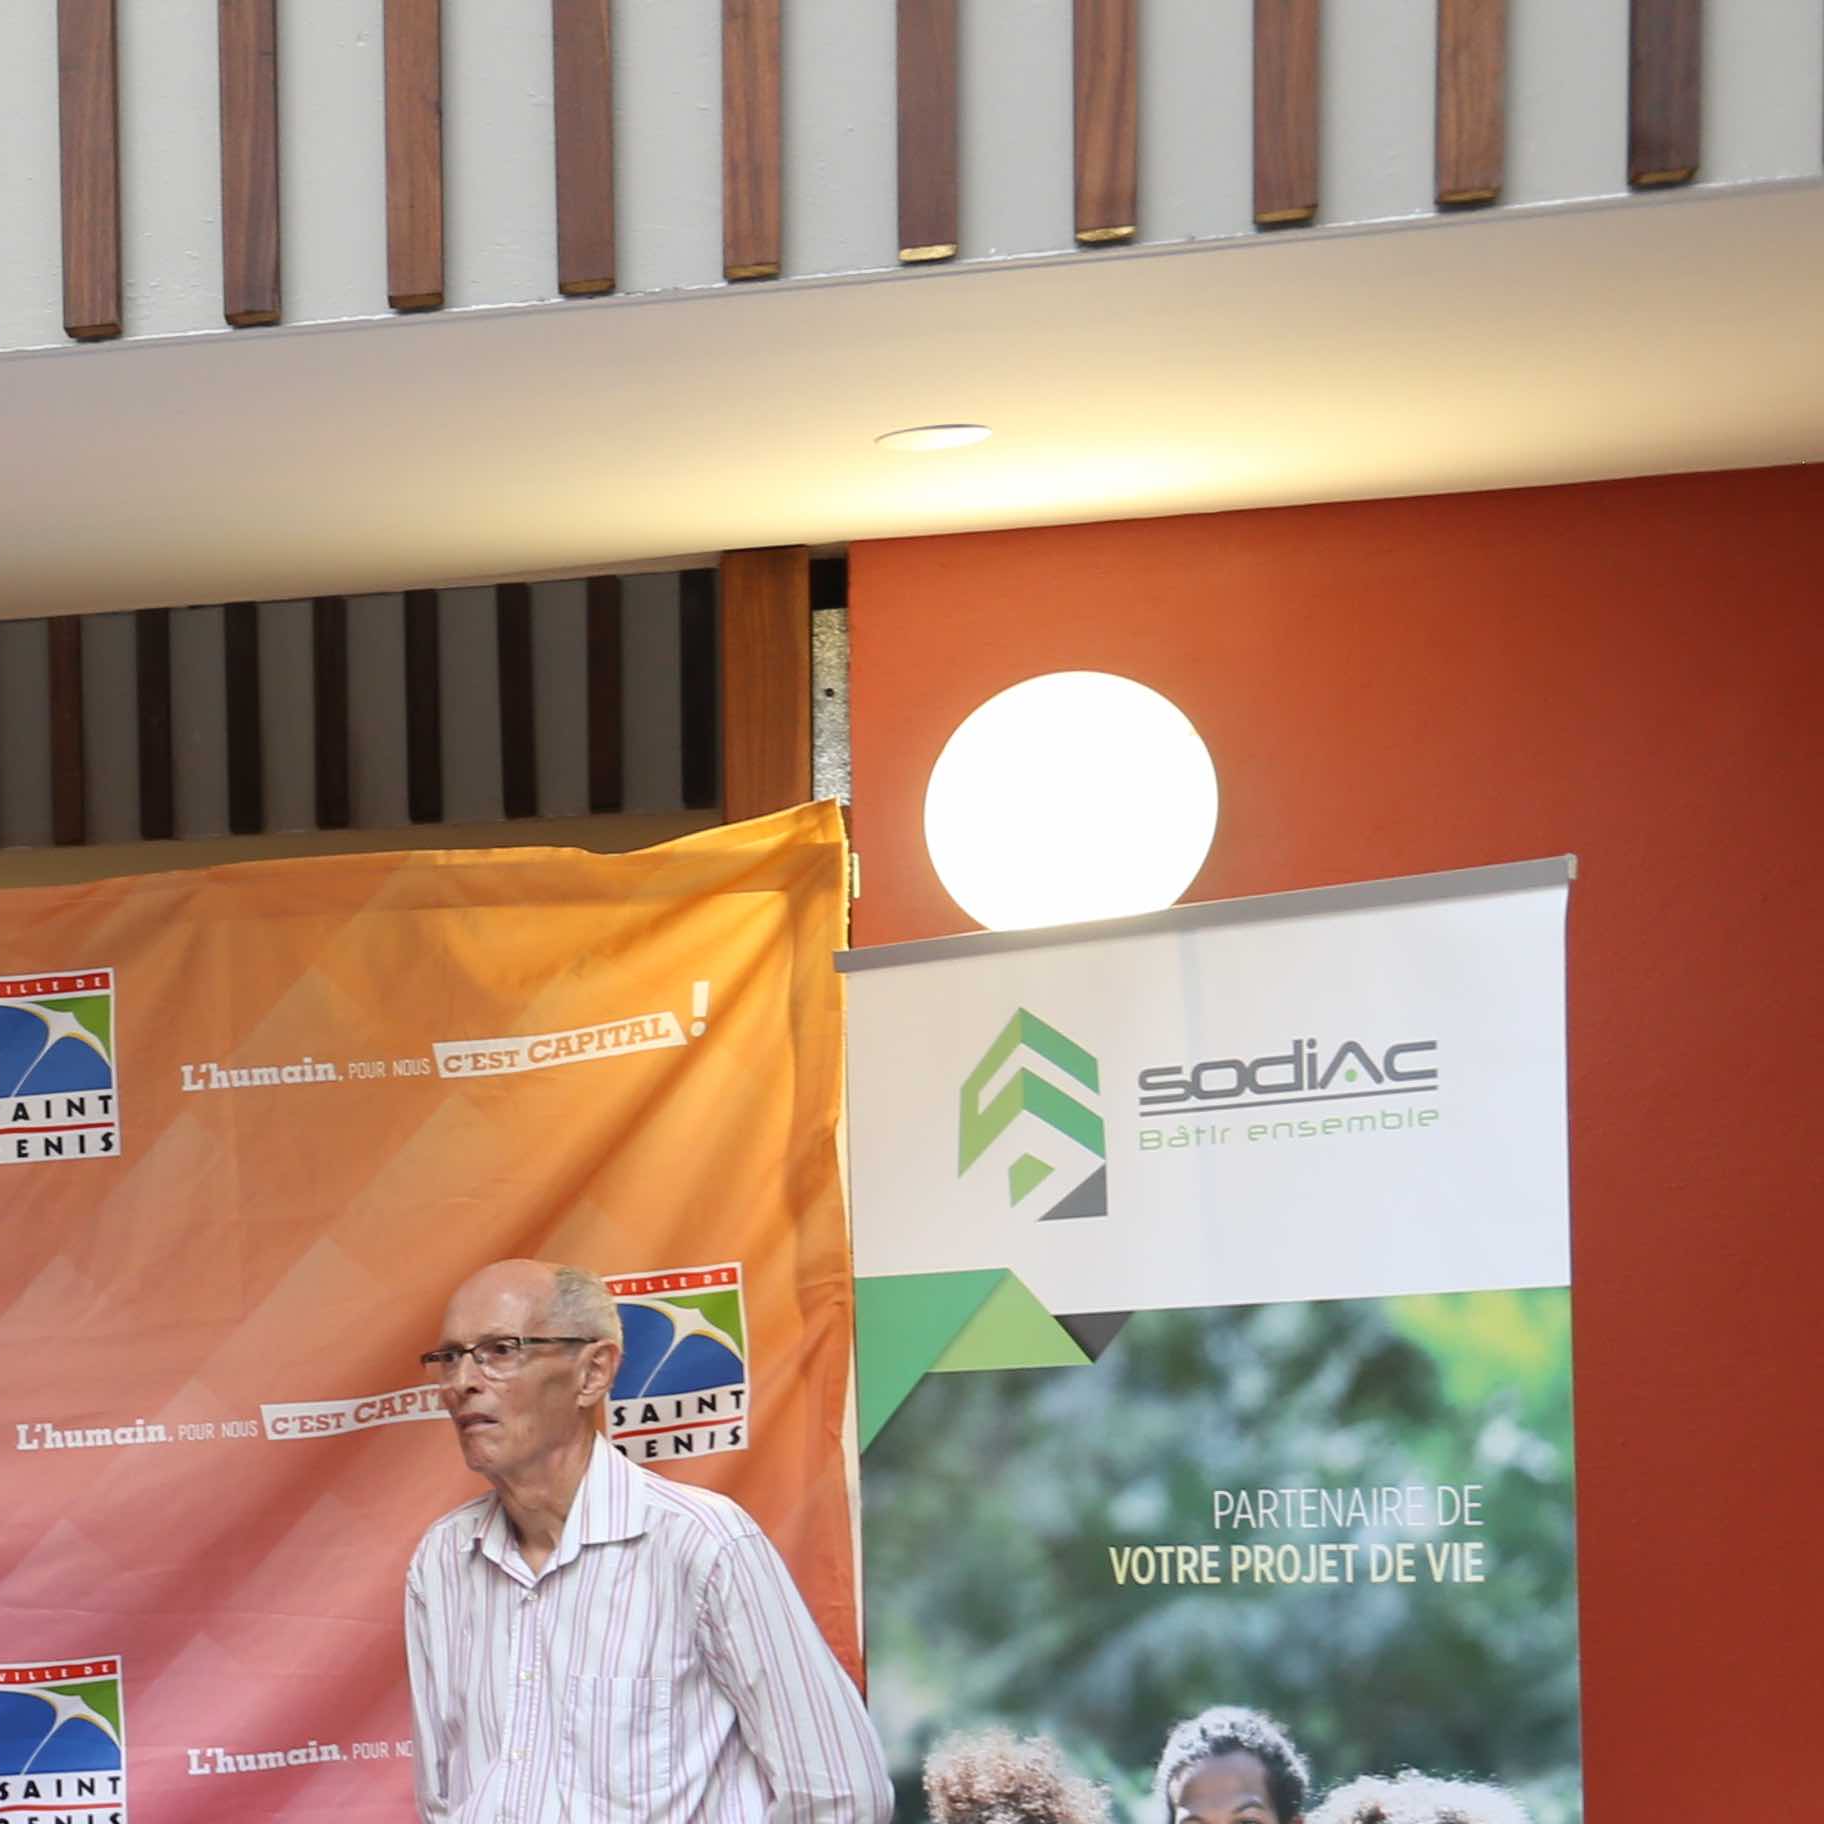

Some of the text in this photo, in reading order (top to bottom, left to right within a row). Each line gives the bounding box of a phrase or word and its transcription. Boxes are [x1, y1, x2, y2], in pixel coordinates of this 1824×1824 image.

[75, 977, 104, 991] DE
[443, 1049, 519, 1074] C'EST
[527, 1017, 671, 1065] CAPITAL
[1139, 1107, 1440, 1152] Bâtir ensemble
[613, 1272, 729, 1294] VILLE DE
[271, 1410, 347, 1437] C'EST
[613, 1390, 744, 1426] SAINT
[1213, 1485, 1484, 1529] PARTENAIRE DE
[1109, 1542, 1484, 1584] VOTRE PROJET DE VIE
[84, 1664, 110, 1677] DE
[353, 1743, 389, 1760] POUR
